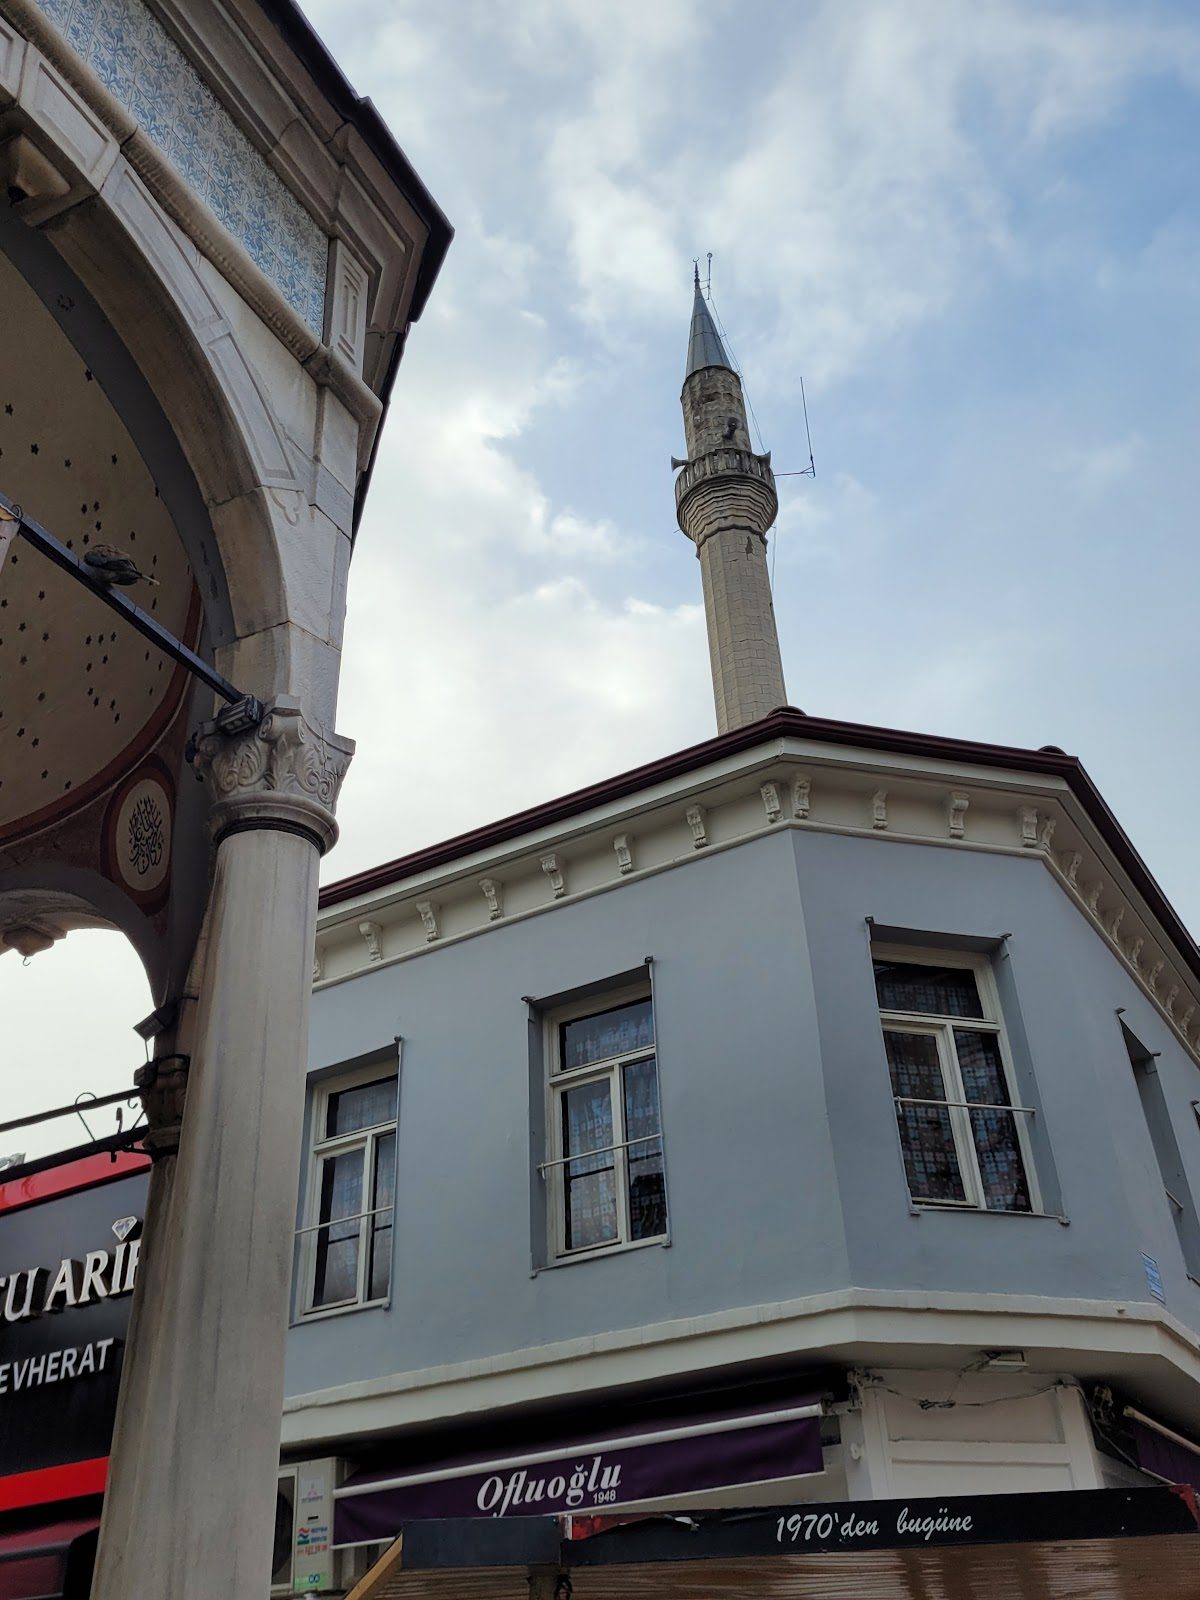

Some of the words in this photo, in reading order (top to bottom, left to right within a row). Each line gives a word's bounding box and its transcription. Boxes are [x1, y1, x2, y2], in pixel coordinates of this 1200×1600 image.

[477, 1456, 622, 1517] Ofluoğlu
[593, 1489, 616, 1504] 1948
[776, 1512, 880, 1542] 1970'den
[896, 1507, 973, 1540] bugüne
